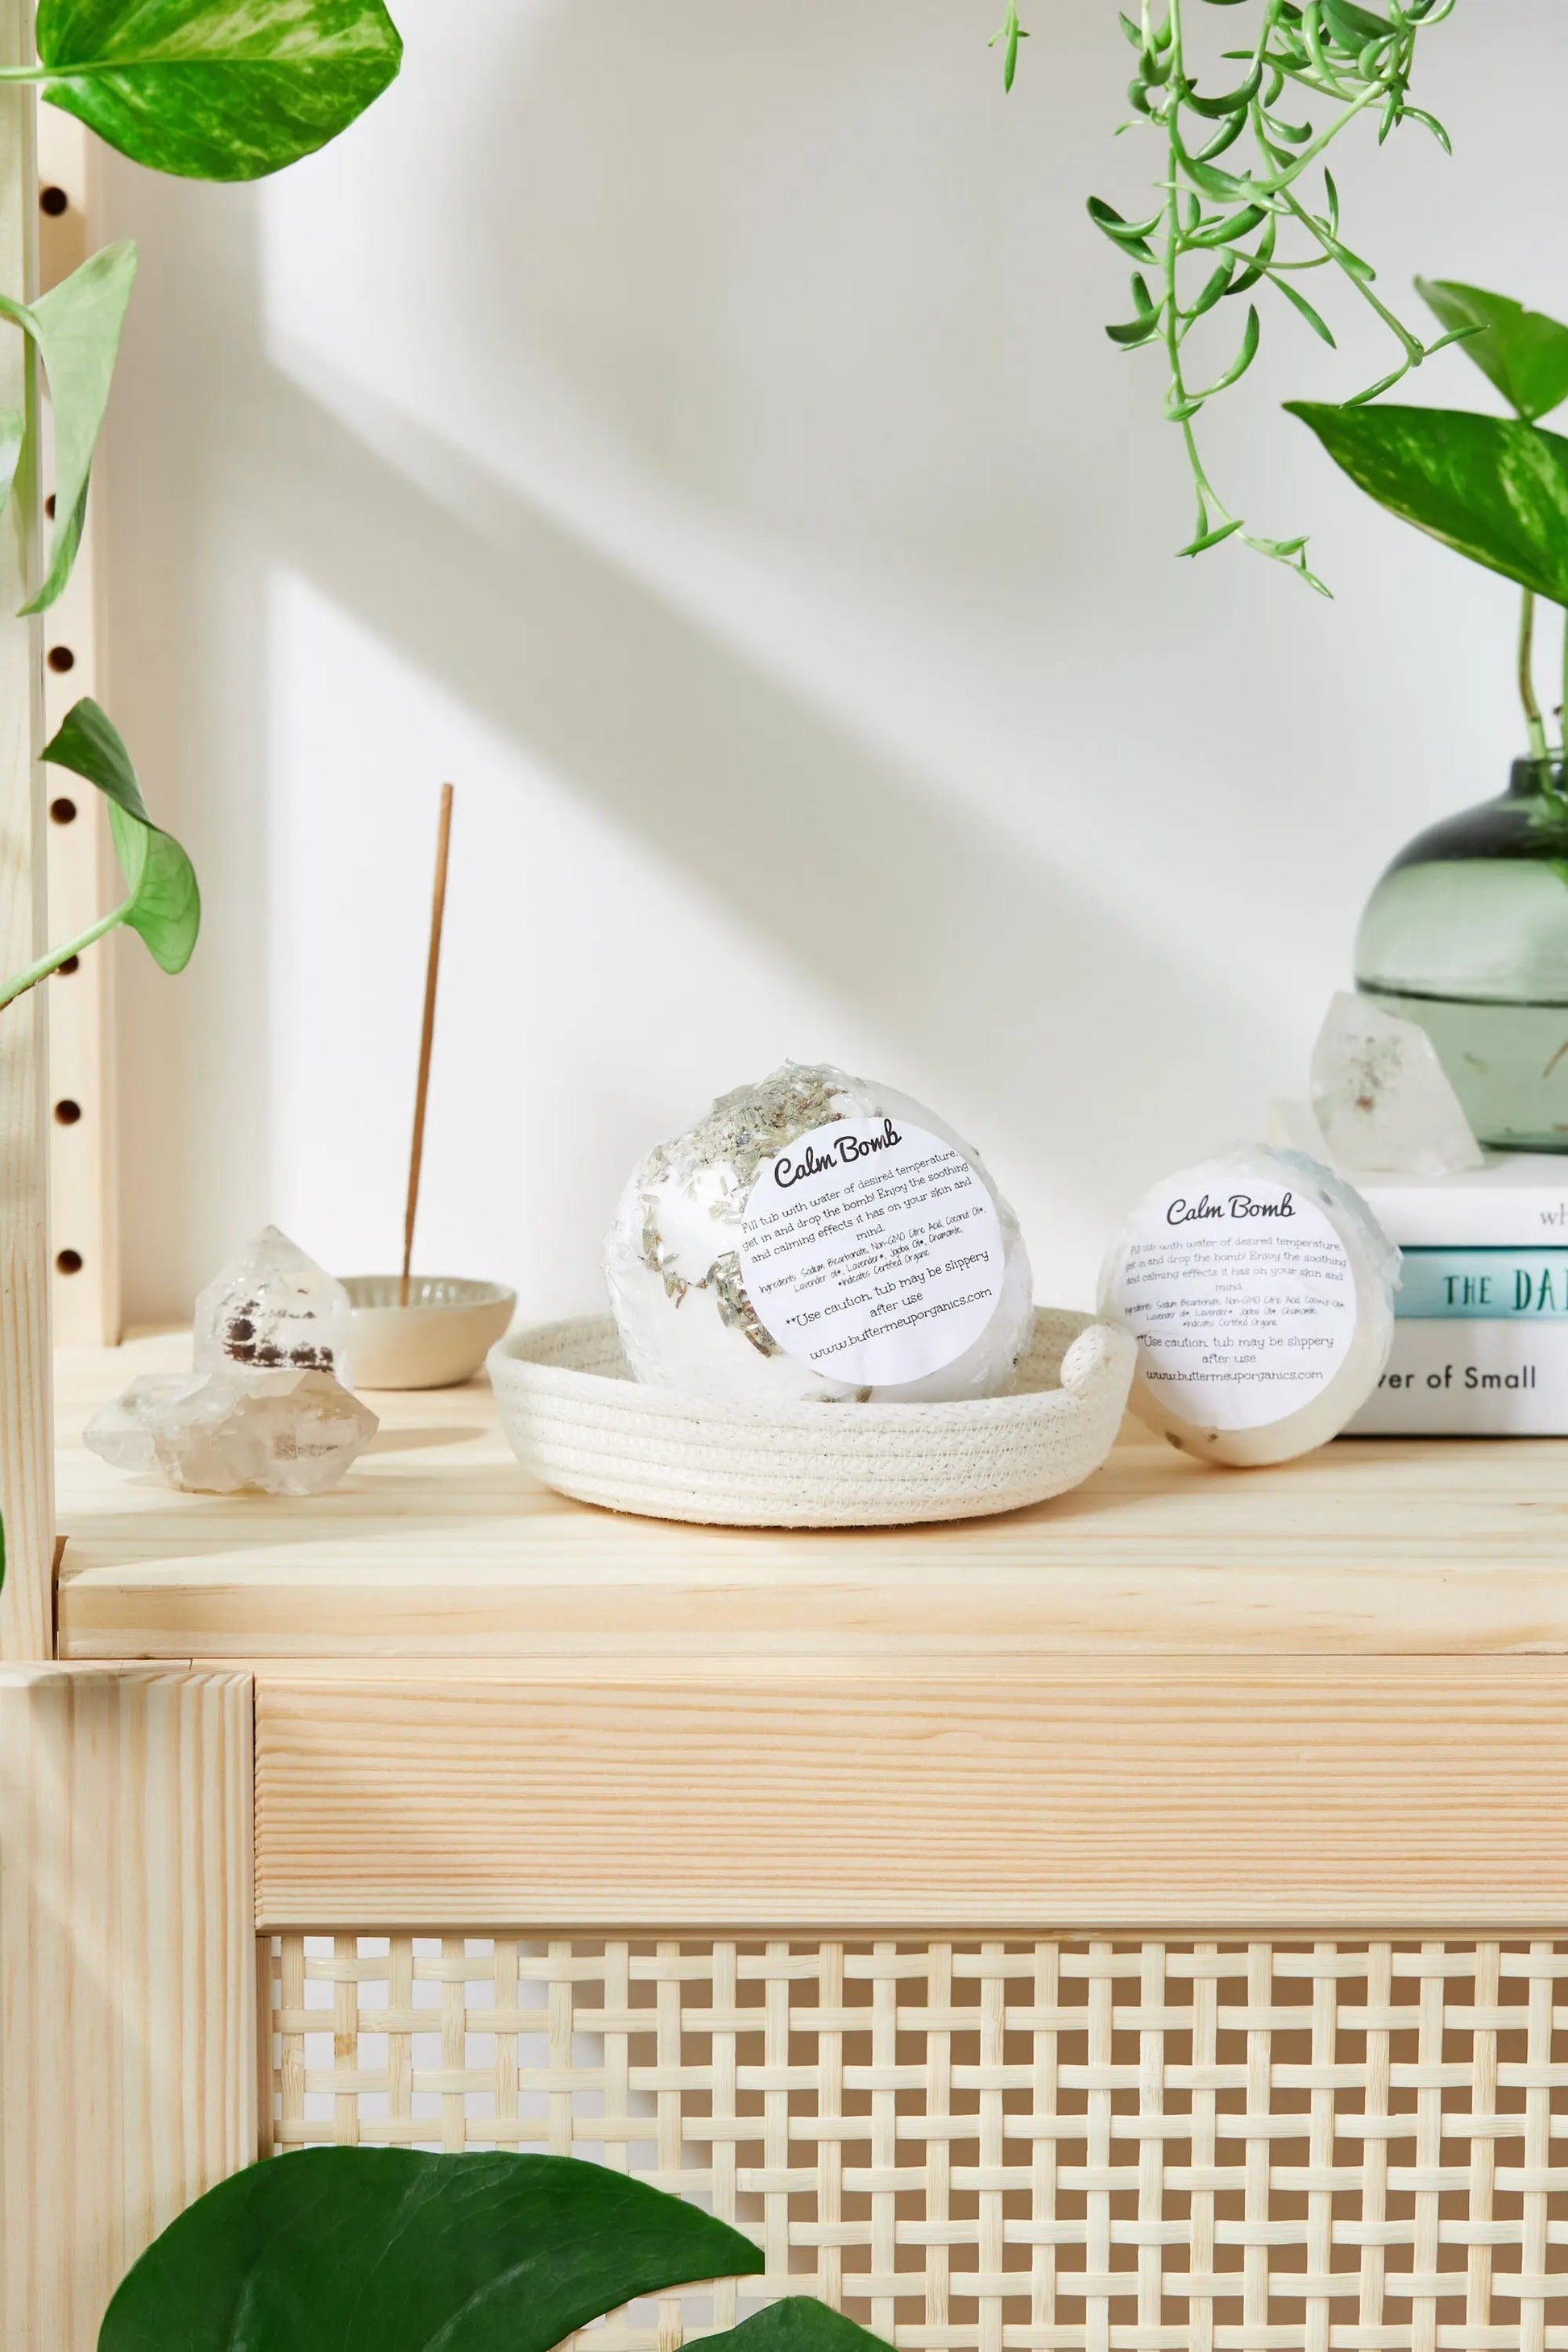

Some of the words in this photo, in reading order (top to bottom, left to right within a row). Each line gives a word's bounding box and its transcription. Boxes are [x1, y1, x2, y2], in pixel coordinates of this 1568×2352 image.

[774, 1146, 838, 1188] Calm
[834, 1118, 902, 1163] Bomb
[741, 1221, 758, 1234] Fill
[760, 1213, 779, 1226] tub
[782, 1203, 807, 1217] with
[810, 1191, 840, 1207] water
[844, 1183, 855, 1194] of
[858, 1169, 894, 1189] desired
[742, 1238, 758, 1251] get
[761, 1234, 772, 1242] in
[774, 1223, 794, 1237] and
[797, 1214, 821, 1229] drop
[823, 1206, 840, 1218] the
[877, 1184, 908, 1200] Enjoy
[909, 1176, 926, 1188] the
[928, 1163, 969, 1182] soothing
[1167, 1194, 1225, 1225] Calm
[1228, 1192, 1296, 1218] Bomb
[751, 1249, 771, 1263] and
[774, 1233, 815, 1255] calming
[818, 1219, 853, 1237] effects
[856, 1213, 865, 1223] it
[865, 1208, 886, 1221] has
[887, 1202, 902, 1213] on
[903, 1193, 928, 1209] your
[931, 1186, 952, 1198] skin
[954, 1176, 973, 1189] and
[856, 1224, 886, 1241] mind.
[801, 1263, 825, 1277] Sodium
[871, 1232, 906, 1251] Non-GMO
[909, 1227, 926, 1238] Citric
[946, 1211, 970, 1226] Coconut
[1159, 1242, 1183, 1251] with
[1186, 1239, 1216, 1248] water
[1220, 1238, 1231, 1247] of
[1234, 1237, 1272, 1245] desired
[793, 1275, 826, 1292] Lavender
[890, 1245, 910, 1259] Jojoba
[874, 1259, 902, 1275] Certified
[905, 1250, 930, 1263] Organic
[1147, 1257, 1164, 1266] and
[1167, 1255, 1191, 1266] drop
[1194, 1254, 1210, 1262] the
[1250, 1251, 1280, 1262] Enjoy
[1284, 1251, 1300, 1261] the
[1304, 1255, 1346, 1268] soothing
[874, 1282, 897, 1296] tub
[899, 1273, 926, 1288] may
[927, 1267, 943, 1279] be
[945, 1251, 989, 1272] slippery
[1126, 1274, 1140, 1284] and
[1143, 1271, 1180, 1282] calming
[1182, 1268, 1217, 1277] effects
[1221, 1268, 1228, 1276] it
[1231, 1267, 1250, 1276] has
[1271, 1267, 1295, 1277] your
[1300, 1268, 1321, 1278] skin
[1325, 1271, 1343, 1280] and
[1444, 1275, 1492, 1305] THE
[870, 1301, 898, 1317] after
[902, 1292, 923, 1306] use
[810, 1288, 992, 1360] www.buttermeuporganics.com
[1213, 1337, 1234, 1347] tub
[1238, 1338, 1265, 1350] may
[1269, 1336, 1284, 1346] be
[1287, 1336, 1334, 1350] slippery
[1201, 1354, 1230, 1363] after
[1234, 1354, 1256, 1363] use
[1146, 1371, 1323, 1383] www.buttermeuporganics.com
[1427, 1364, 1454, 1389] of
[1465, 1364, 1536, 1389] Small
